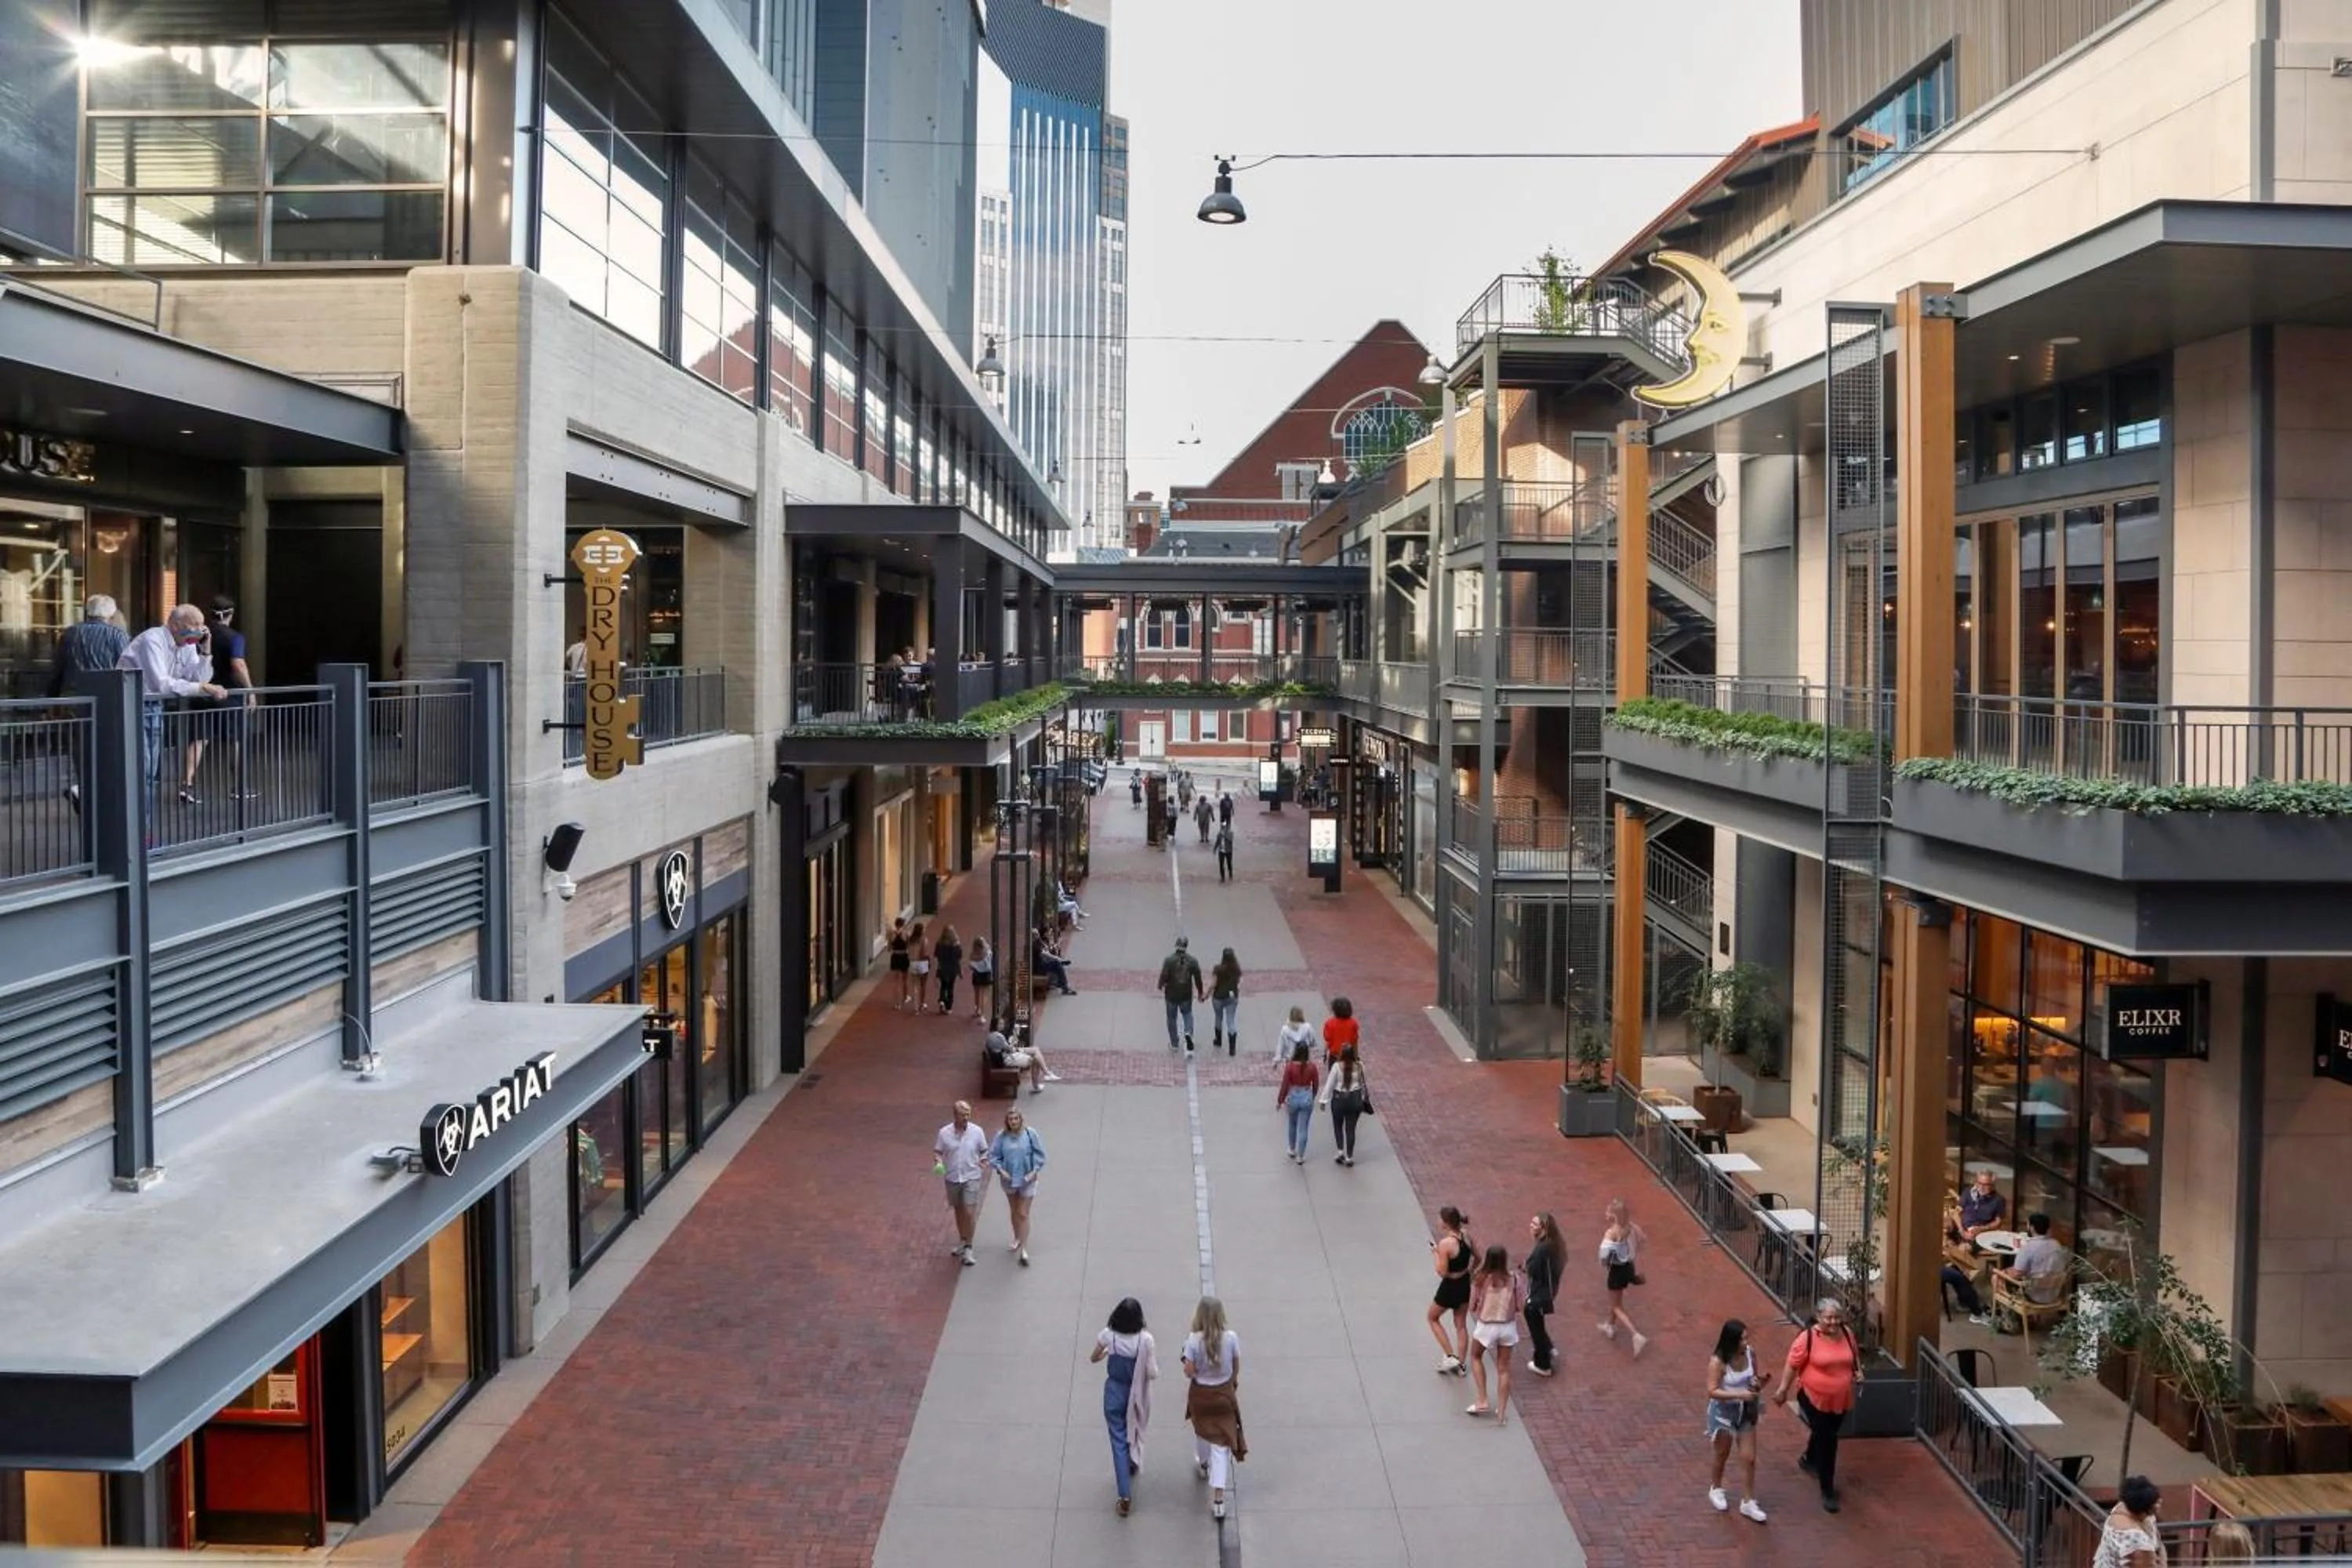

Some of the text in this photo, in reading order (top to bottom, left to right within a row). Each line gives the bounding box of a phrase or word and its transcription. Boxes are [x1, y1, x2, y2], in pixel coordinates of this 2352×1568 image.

[590, 586, 616, 773] DRY HOUSE
[2118, 1009, 2182, 1026] ELIXR
[2129, 1027, 2171, 1036] COFFEE
[466, 1051, 557, 1151] ARIAT
